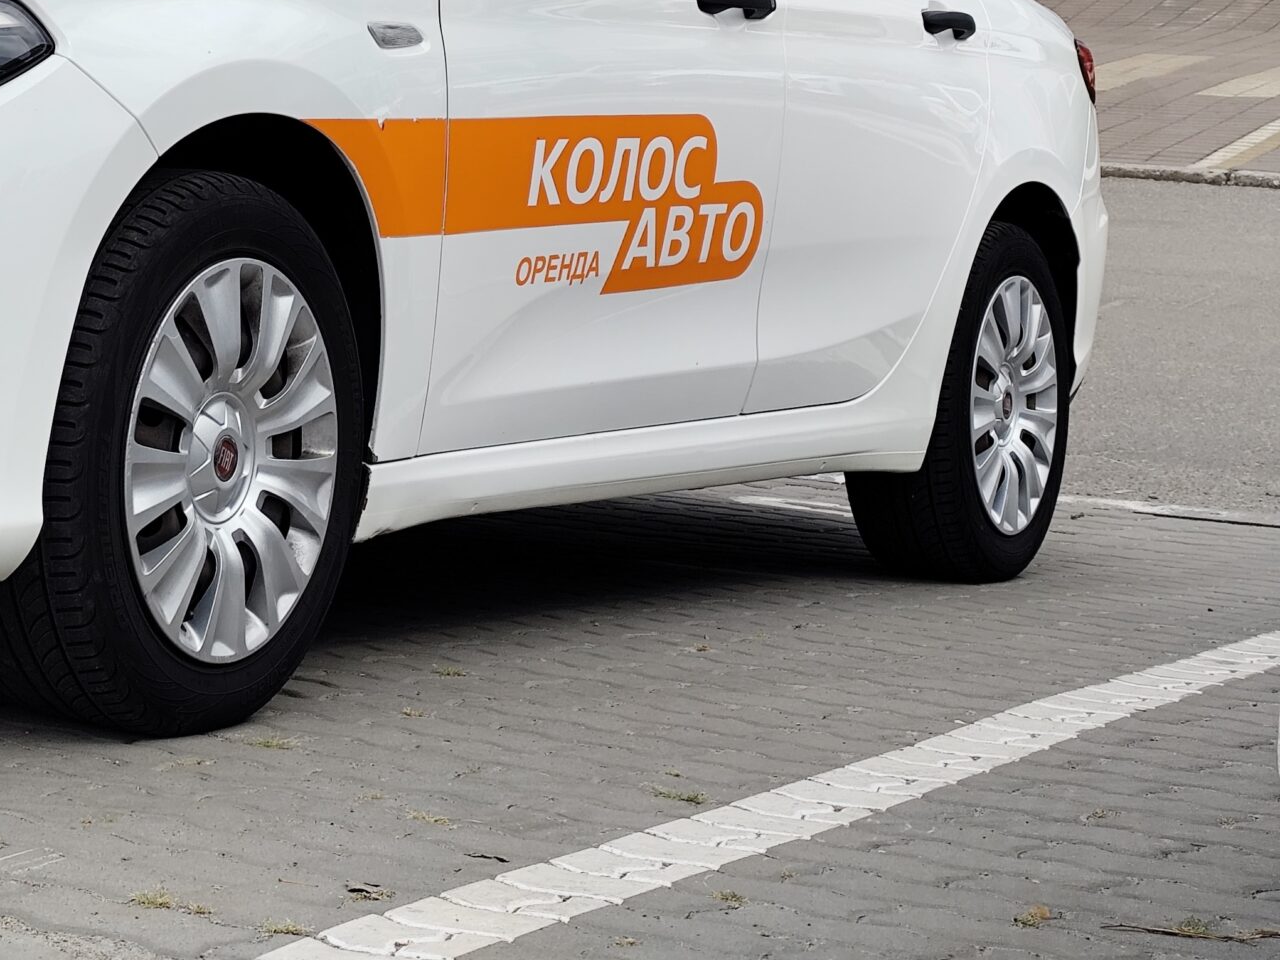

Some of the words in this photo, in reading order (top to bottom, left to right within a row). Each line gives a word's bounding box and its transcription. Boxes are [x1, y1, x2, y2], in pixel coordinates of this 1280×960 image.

[527, 135, 708, 207] КОЛОС
[621, 201, 756, 271] АВТО
[515, 250, 600, 287] ОРЕНДА
[217, 446, 235, 472] FIAT
